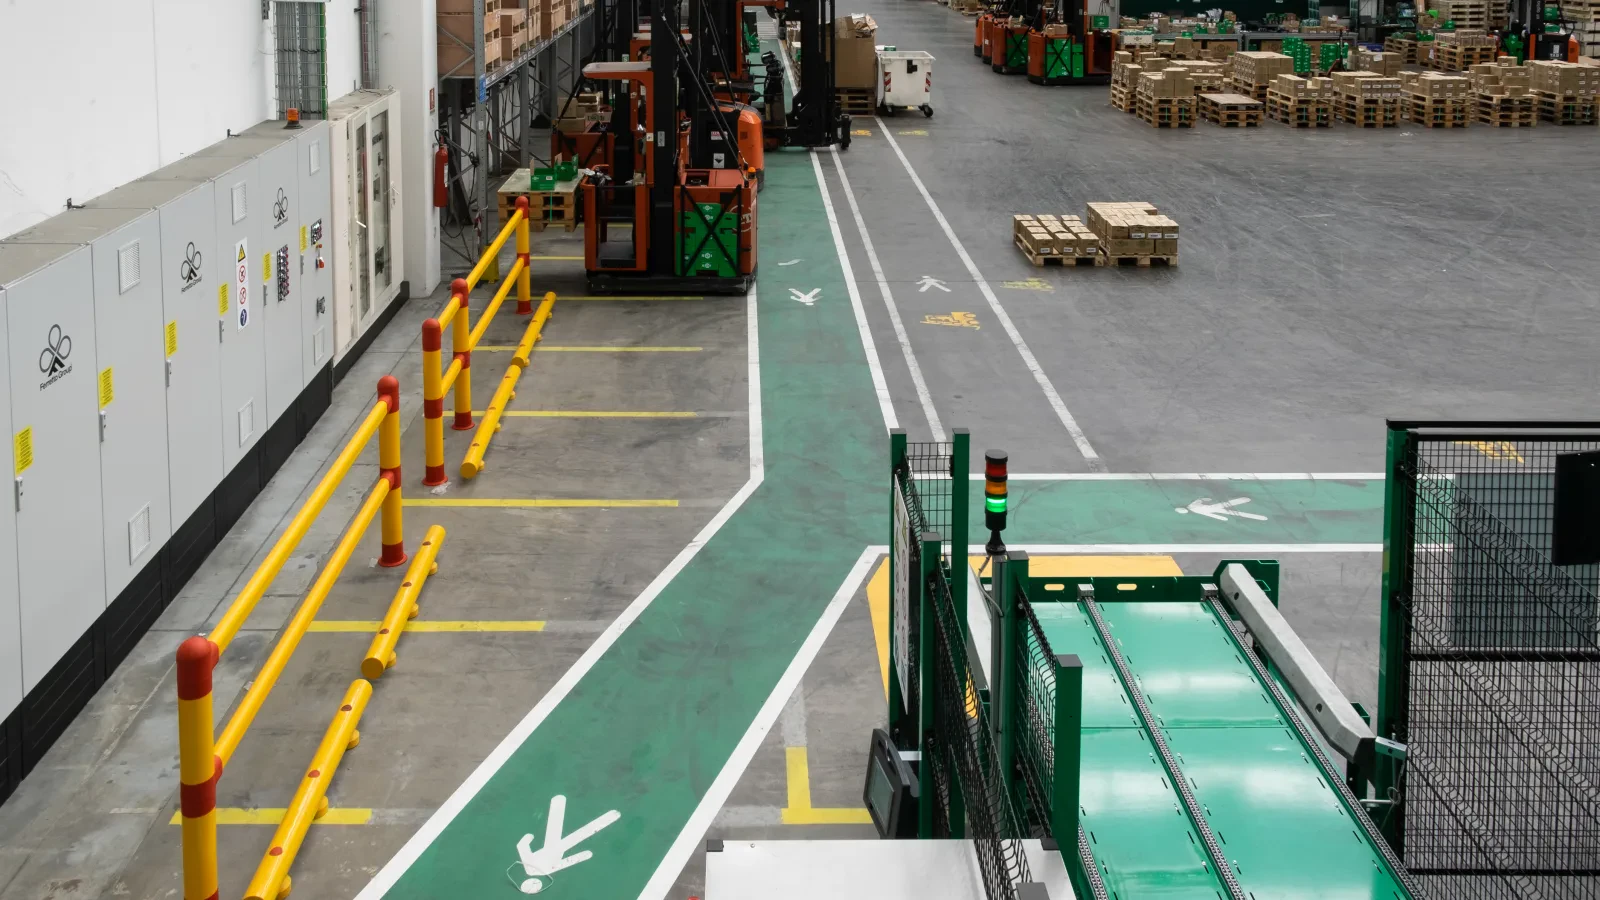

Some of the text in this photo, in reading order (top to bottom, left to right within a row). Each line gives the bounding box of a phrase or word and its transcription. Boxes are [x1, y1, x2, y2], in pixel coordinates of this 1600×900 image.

[181, 275, 202, 293] Ferretto Group
[40, 364, 72, 391] Ferretto Group
